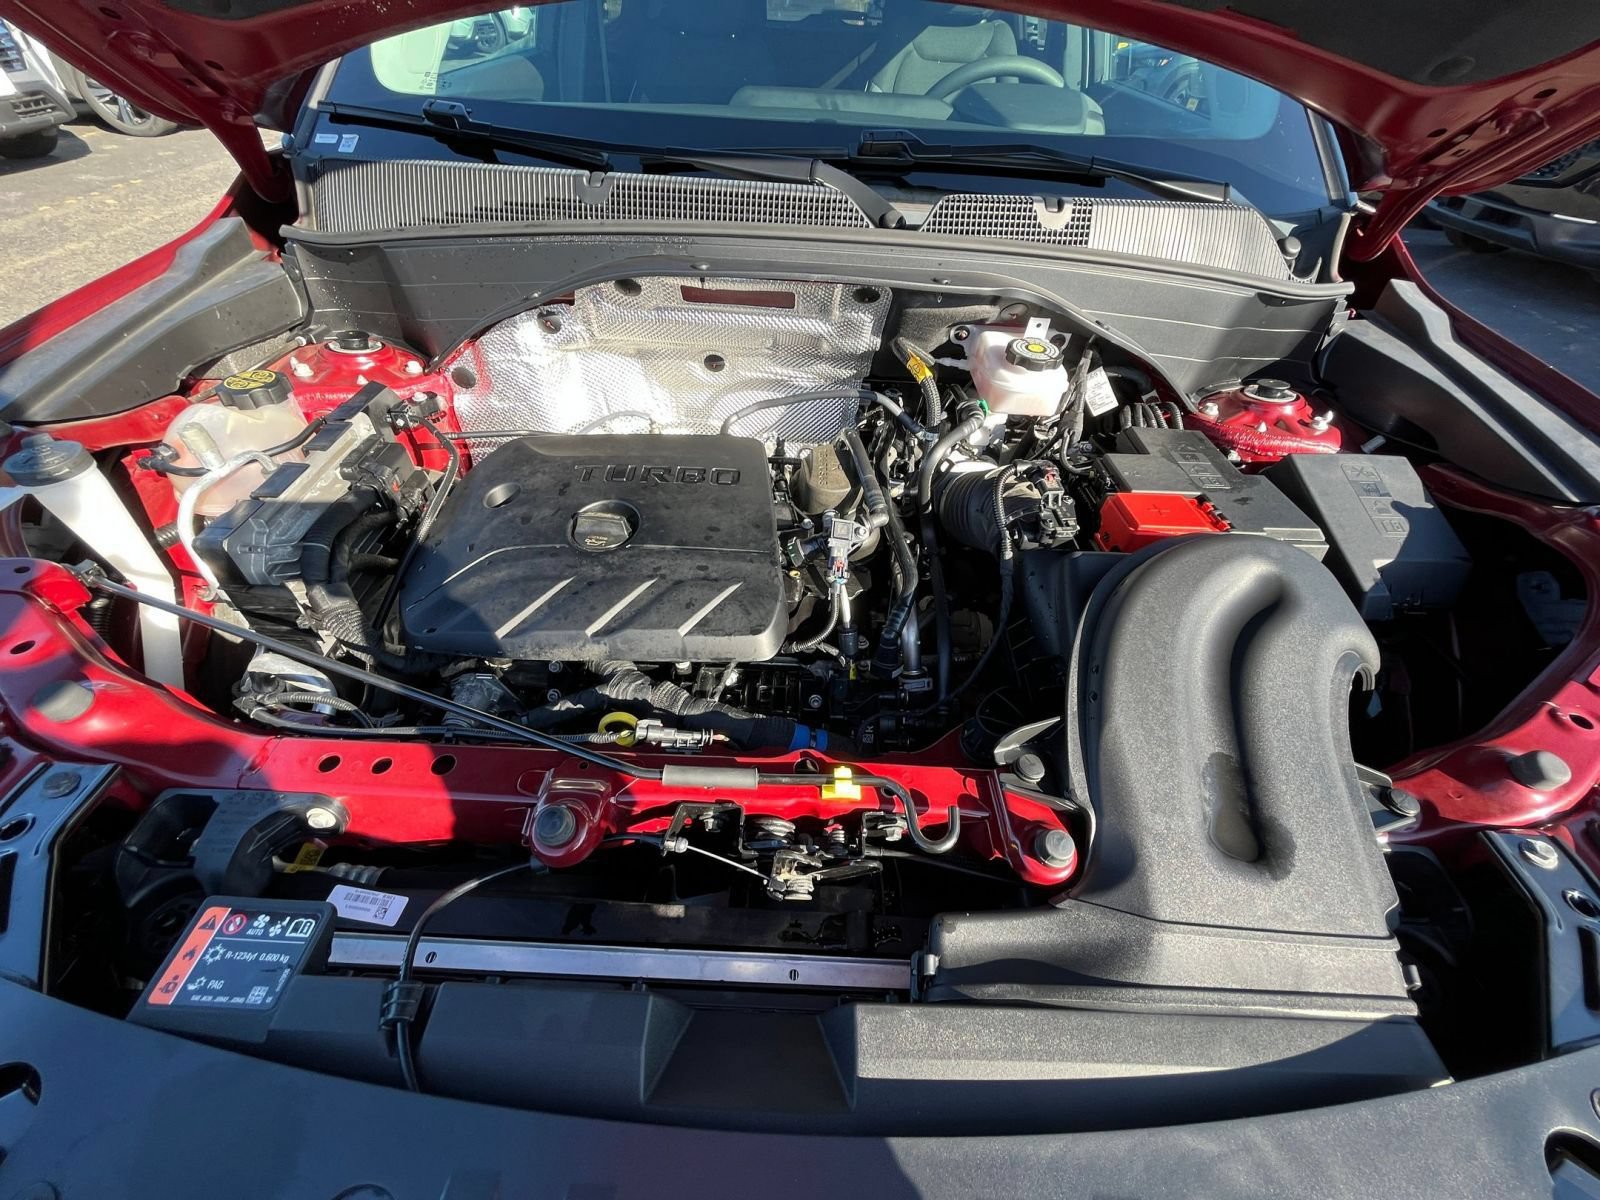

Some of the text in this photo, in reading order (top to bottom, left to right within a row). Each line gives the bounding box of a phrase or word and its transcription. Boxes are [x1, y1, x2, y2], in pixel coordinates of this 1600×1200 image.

[575, 465, 741, 486] TURBO
[246, 928, 264, 936] AUTO
[259, 952, 280, 962] 0.600
[279, 953, 290, 964] kg
[206, 979, 225, 990] PAG
